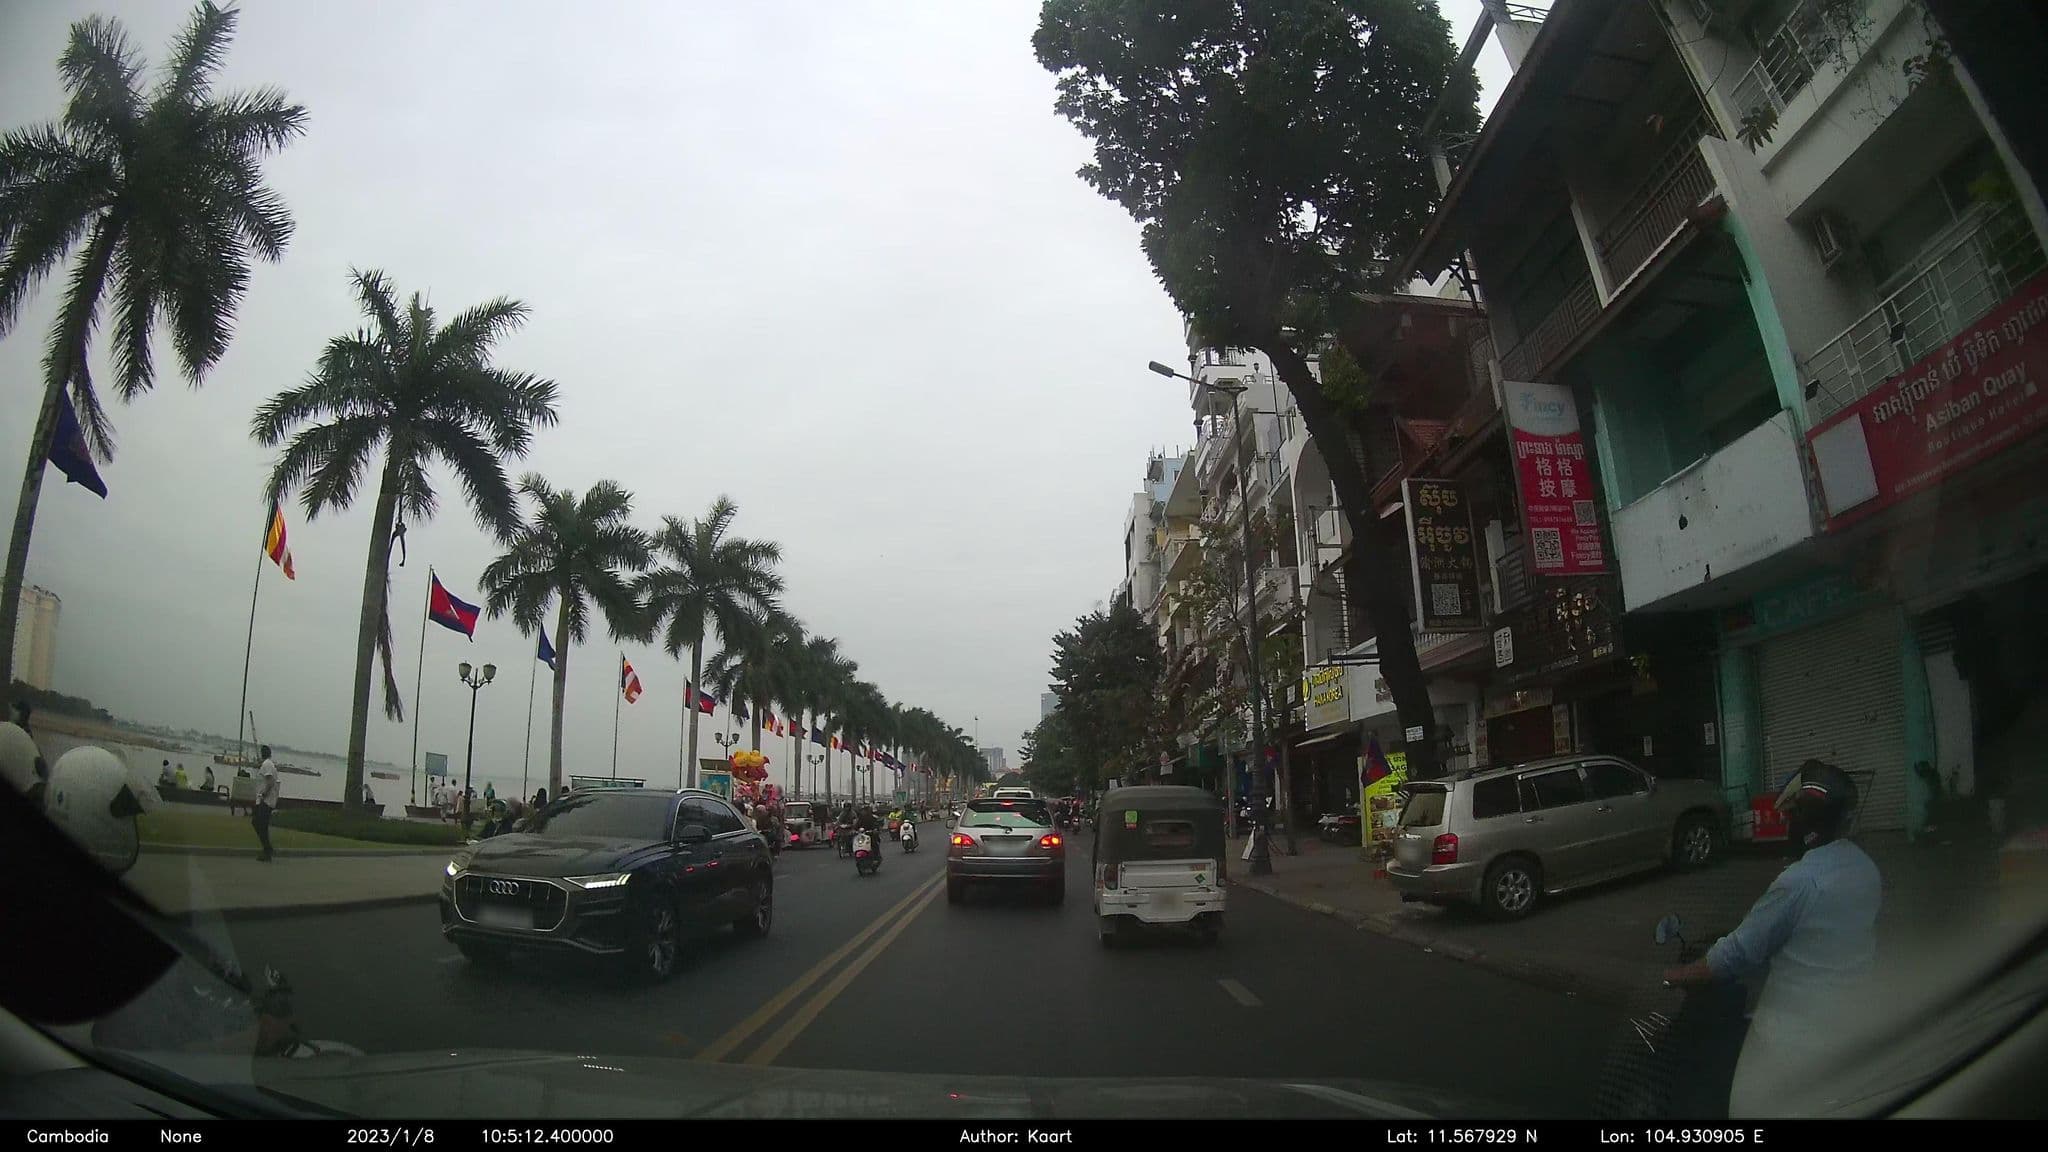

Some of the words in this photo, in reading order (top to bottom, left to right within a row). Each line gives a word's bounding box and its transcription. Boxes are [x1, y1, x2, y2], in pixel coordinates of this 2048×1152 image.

[1926, 390, 1981, 434] Asiban
[1983, 361, 2026, 397] Quay
[1536, 457, 1573, 476] 格格
[1538, 478, 1578, 497] 按摩
